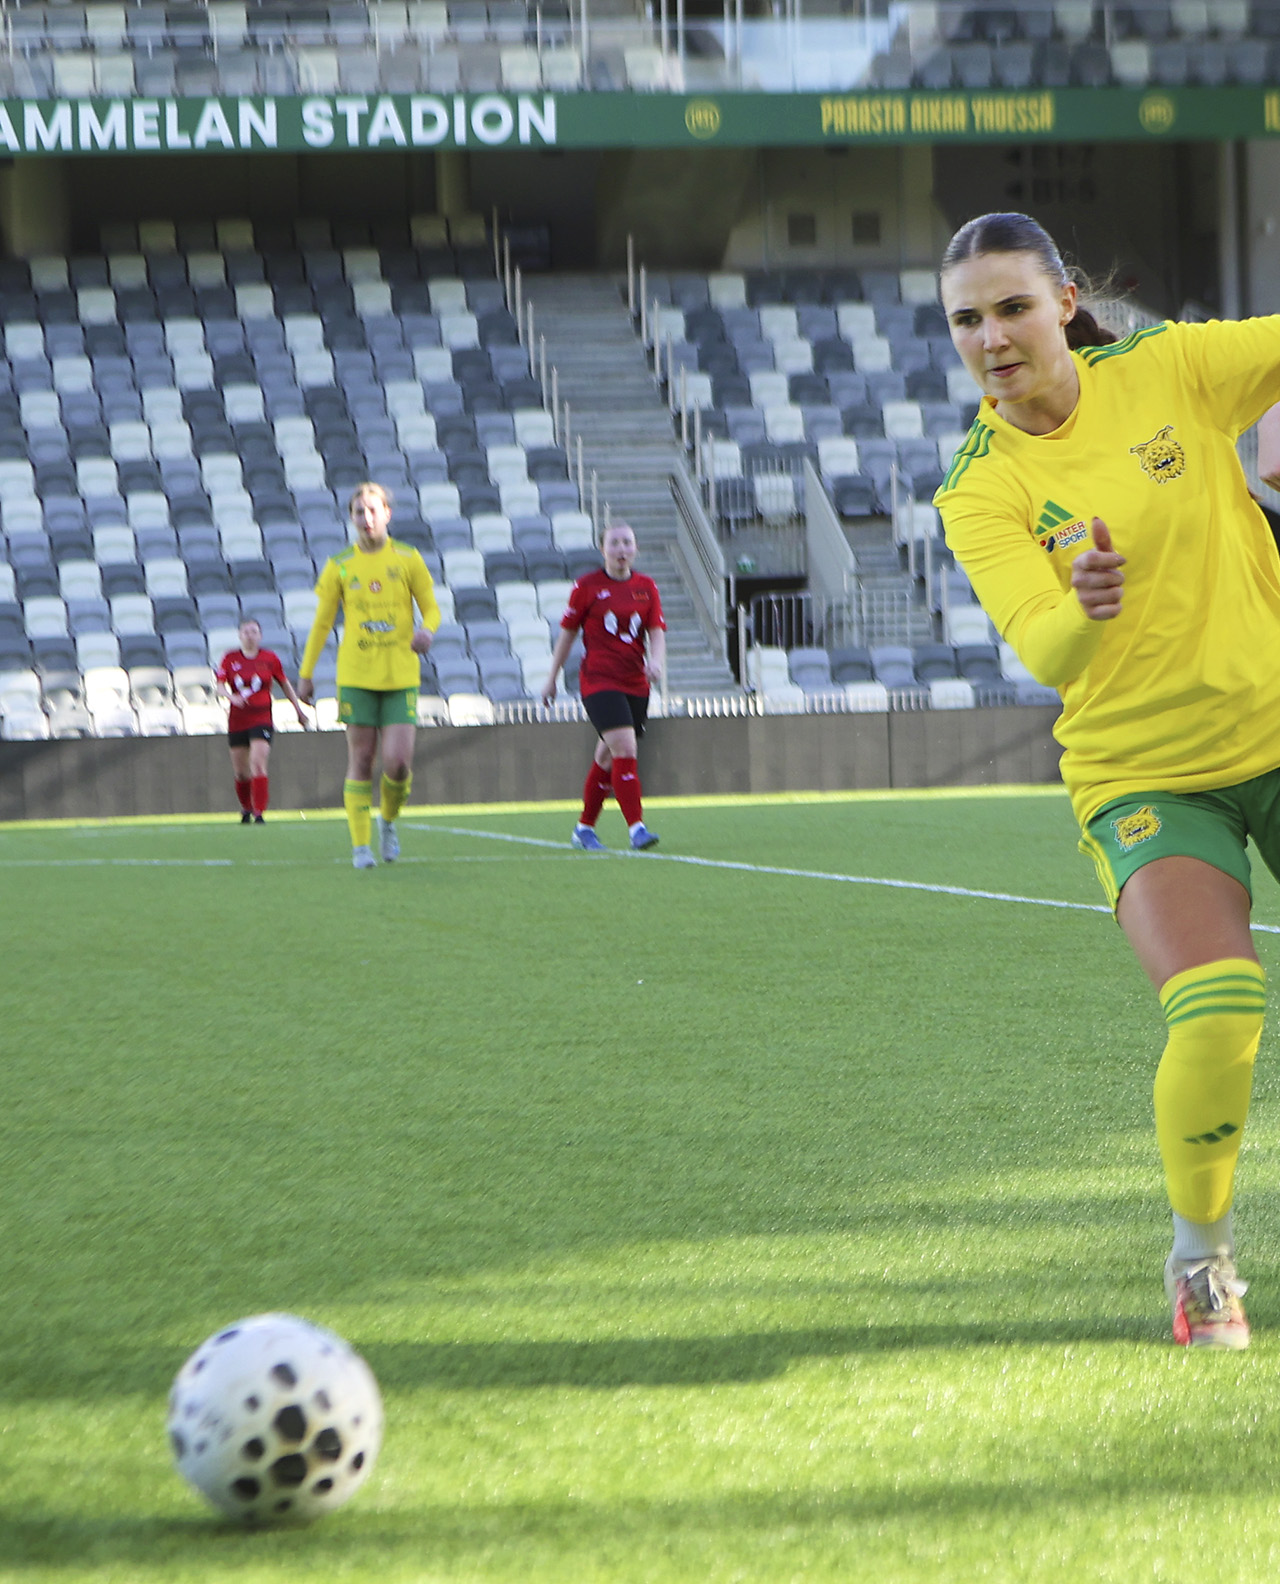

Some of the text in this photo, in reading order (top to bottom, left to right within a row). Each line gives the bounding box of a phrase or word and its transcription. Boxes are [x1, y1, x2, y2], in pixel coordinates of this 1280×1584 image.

[302, 96, 557, 149] STADION
[820, 97, 906, 135] PARASTA
[911, 97, 967, 132] AIKAA
[1055, 521, 1086, 541] INTER
[1058, 529, 1088, 549] SPORT
